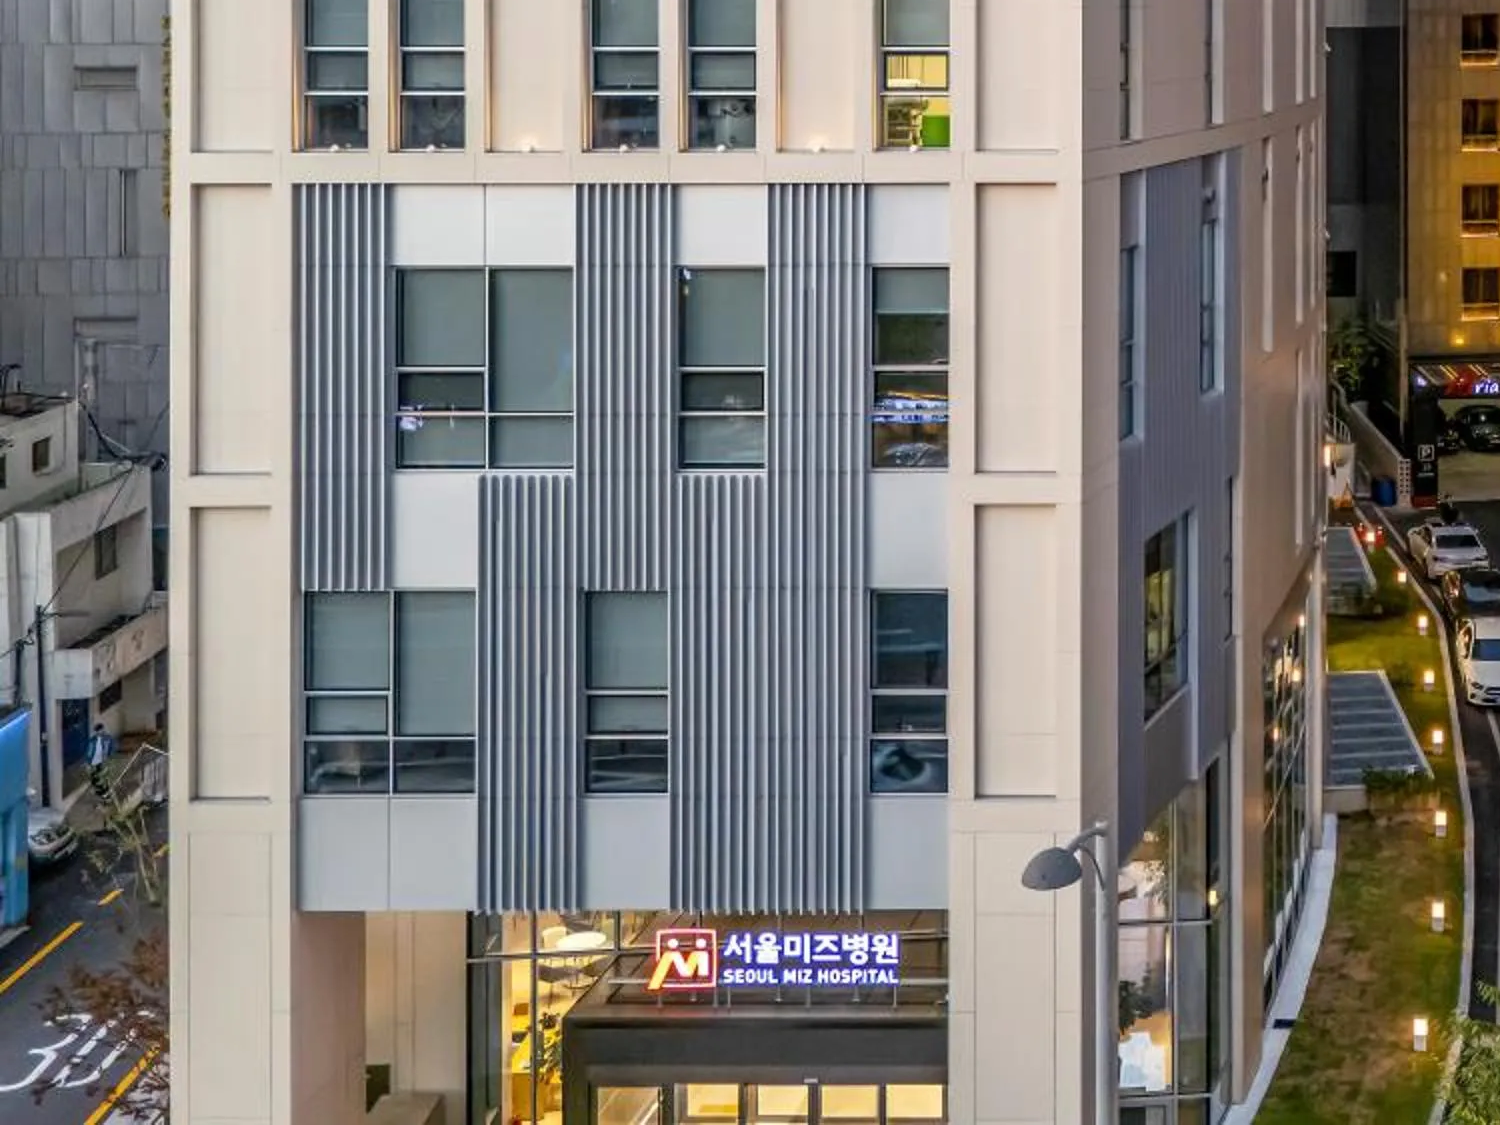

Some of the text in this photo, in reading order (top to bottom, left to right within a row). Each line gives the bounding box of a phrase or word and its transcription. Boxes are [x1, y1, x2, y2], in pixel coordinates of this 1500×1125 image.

[723, 932, 899, 965] 서울미즈병원
[723, 968, 899, 984] SEOUL MIZ HOSPITAL
